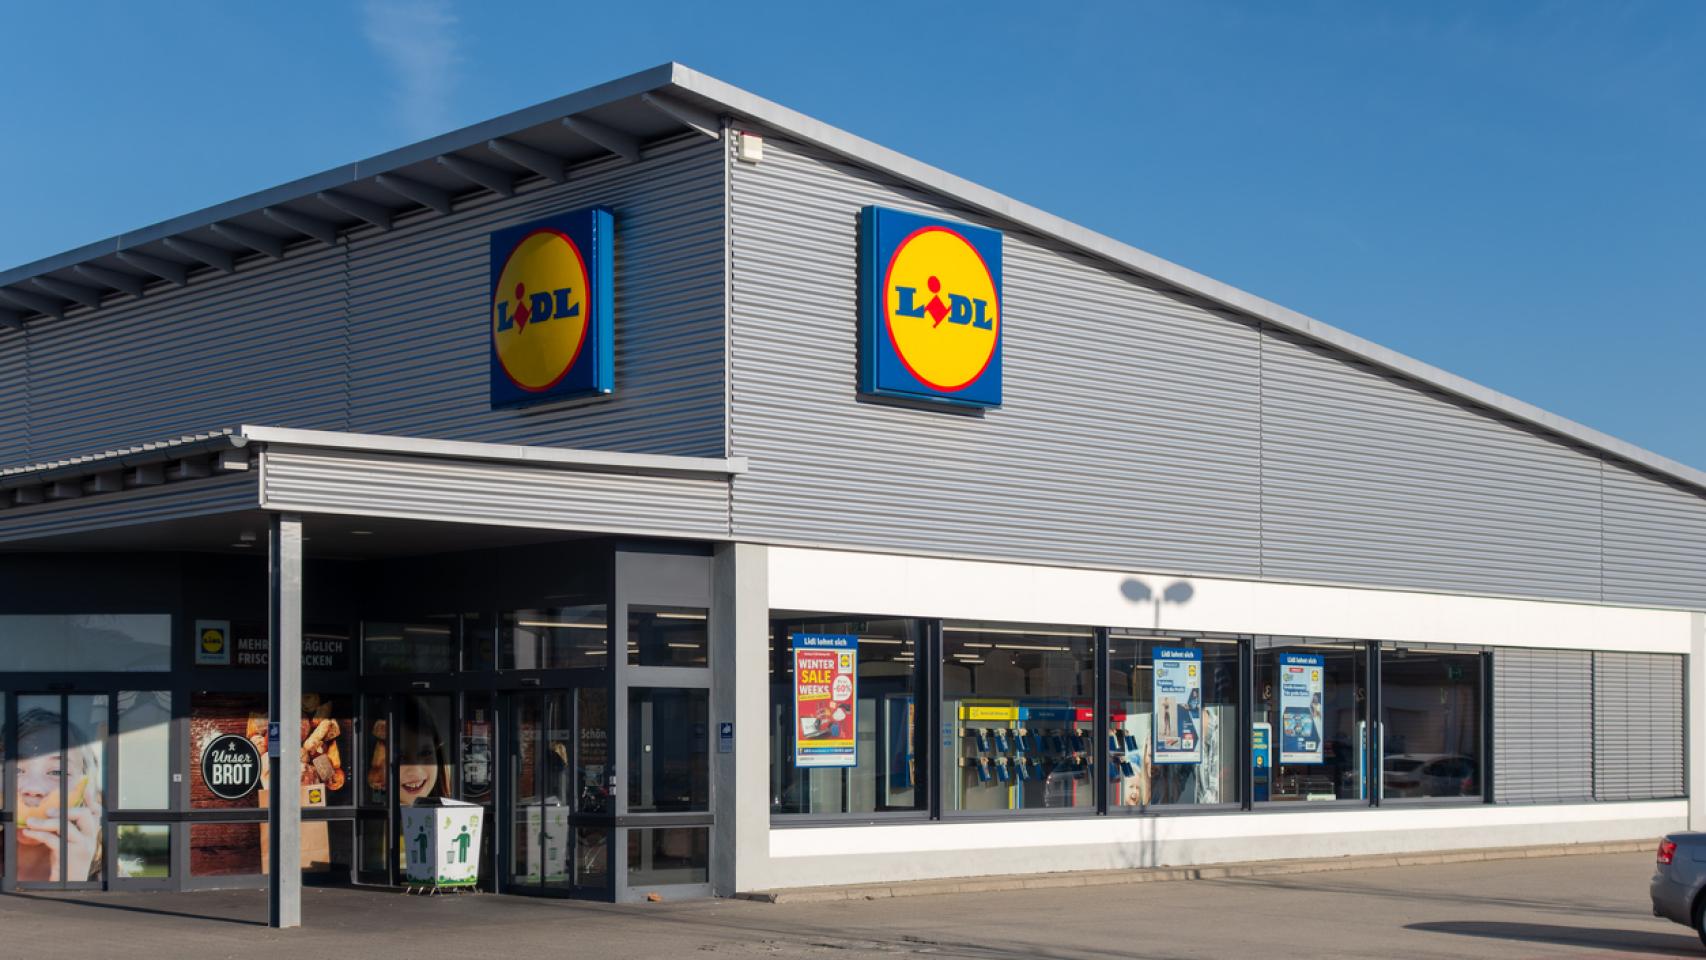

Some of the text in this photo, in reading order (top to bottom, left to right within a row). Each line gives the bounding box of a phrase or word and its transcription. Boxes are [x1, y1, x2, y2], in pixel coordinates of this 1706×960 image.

[238, 653, 268, 665] FRISC
[799, 659, 835, 669] WINTER
[801, 670, 831, 684] SALE
[800, 685, 829, 695] WEEKS
[212, 750, 252, 763] Unser
[212, 763, 253, 785] BROT
